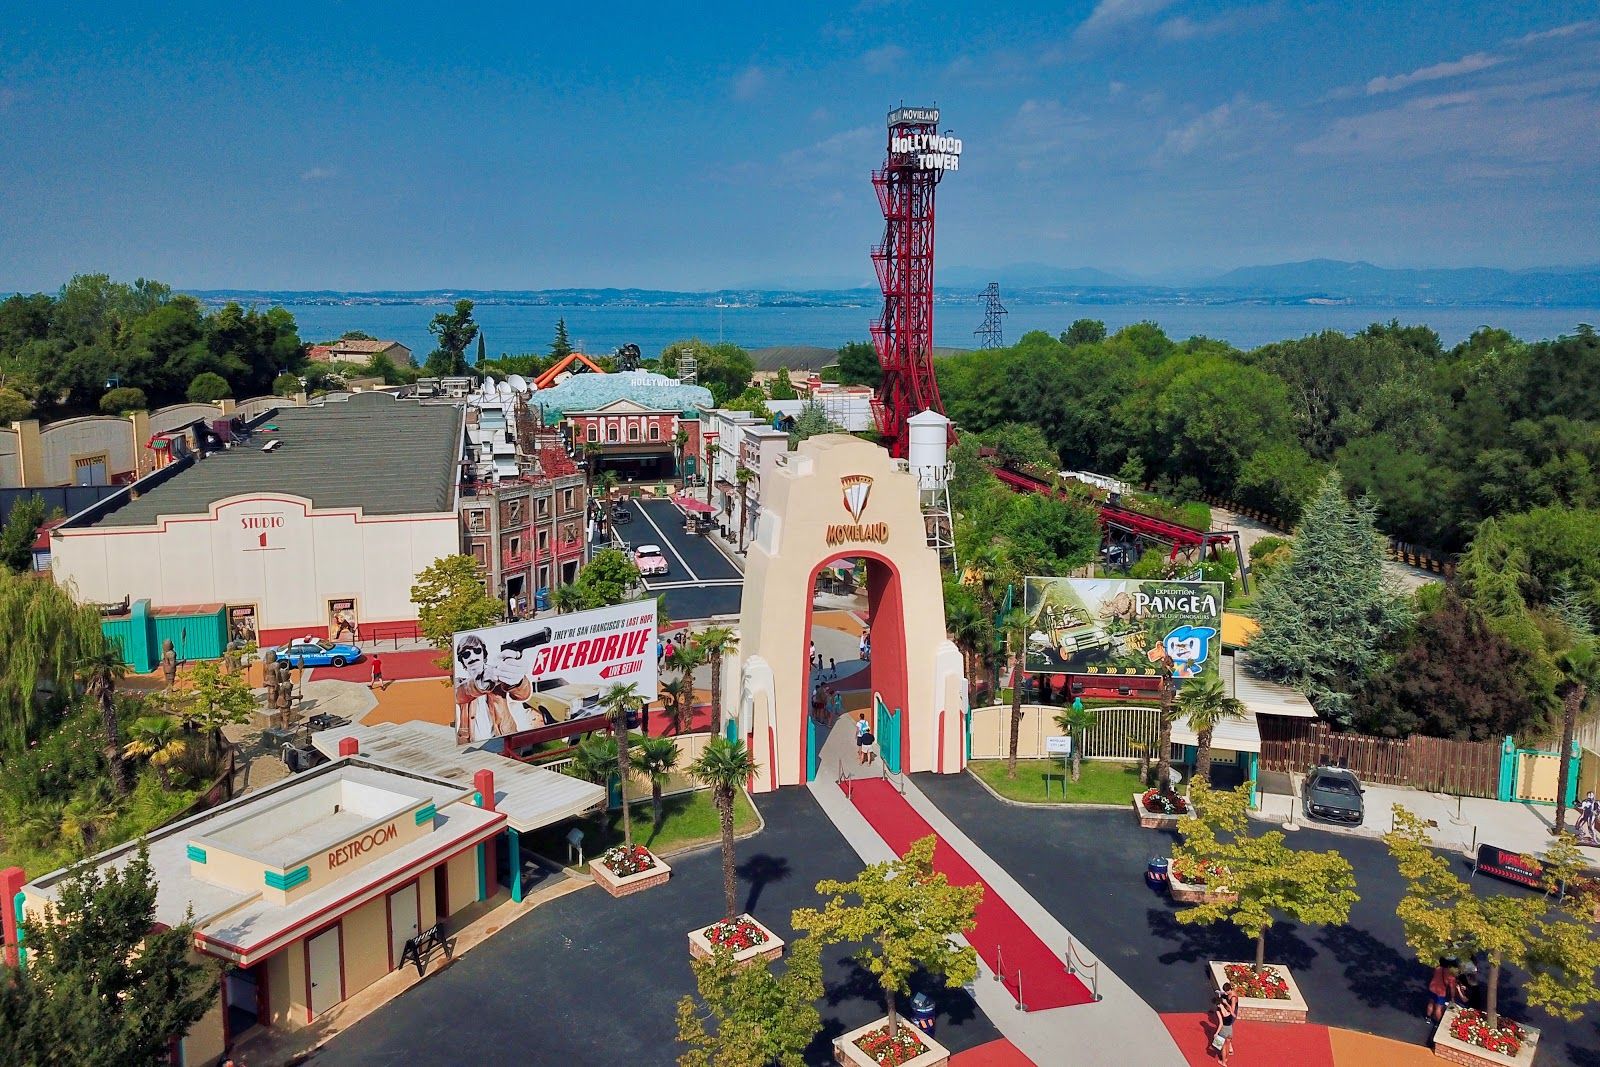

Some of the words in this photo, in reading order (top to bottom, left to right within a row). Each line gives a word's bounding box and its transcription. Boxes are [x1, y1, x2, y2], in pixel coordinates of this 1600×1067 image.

[902, 109, 939, 121] MOVIELAND
[891, 134, 962, 155] HOLLYWOOD
[918, 153, 959, 171] TOWER
[631, 378, 680, 387] HOLLYWOOD
[241, 516, 285, 529] STUDIO
[258, 532, 267, 547] 1
[826, 522, 889, 547] MOVIELAND
[1155, 588, 1196, 596] EXPEDITION
[1132, 592, 1217, 617] PANGEA
[554, 627, 576, 641] THEY'RE
[577, 625, 590, 637] SAN
[590, 618, 626, 634] FRANCISCO'S
[626, 616, 640, 628] LAST
[640, 613, 654, 625] HOPE
[532, 628, 652, 675] OVERDRIVE
[608, 665, 621, 677] LIVE
[621, 662, 634, 674] SET
[328, 823, 398, 870] RESTROOM
